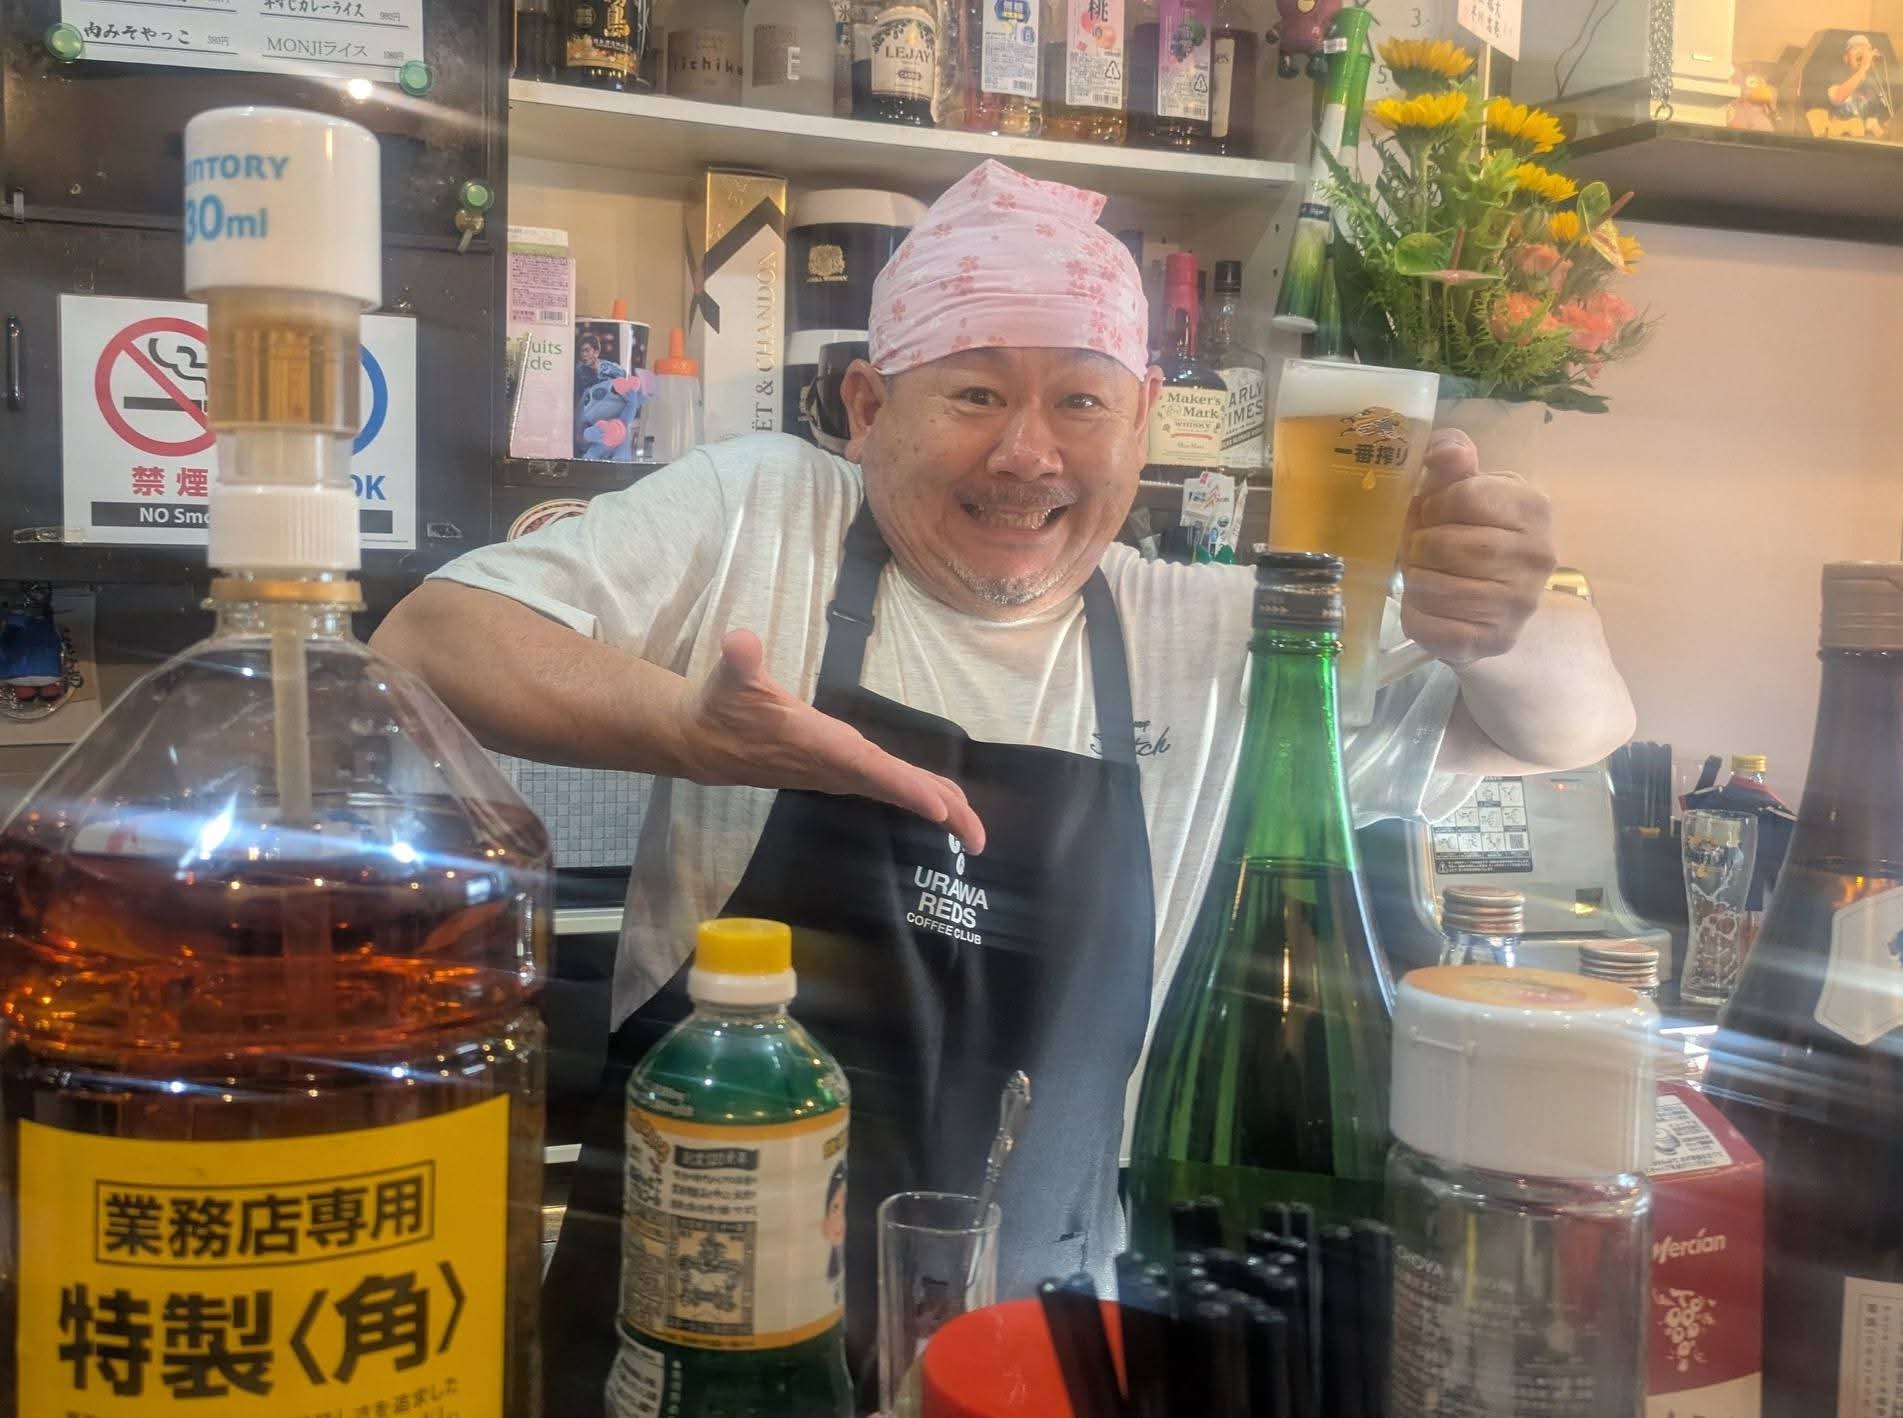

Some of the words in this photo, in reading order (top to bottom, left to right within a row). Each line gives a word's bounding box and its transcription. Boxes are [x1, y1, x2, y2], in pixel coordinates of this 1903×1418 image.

[84, 21, 190, 45] 肉みそやっこ
[267, 37, 368, 57] MONJIライス
[885, 46, 931, 62] LEJAY
[185, 154, 290, 180] NTORY
[755, 250, 778, 373] CHANDON
[530, 341, 563, 355] uits
[755, 379, 774, 396] &
[1167, 391, 1222, 406] Maker's
[1228, 380, 1264, 408] ARLY
[751, 402, 774, 434] ËT
[1183, 406, 1218, 419] Mark
[132, 466, 209, 497] 禁煙
[140, 507, 170, 523] NO
[914, 866, 988, 910] URAWA
[918, 892, 976, 929] REDS
[906, 912, 954, 937] COFFEE
[953, 928, 982, 945] CLUB
[105, 1174, 425, 1258] 業務店専用
